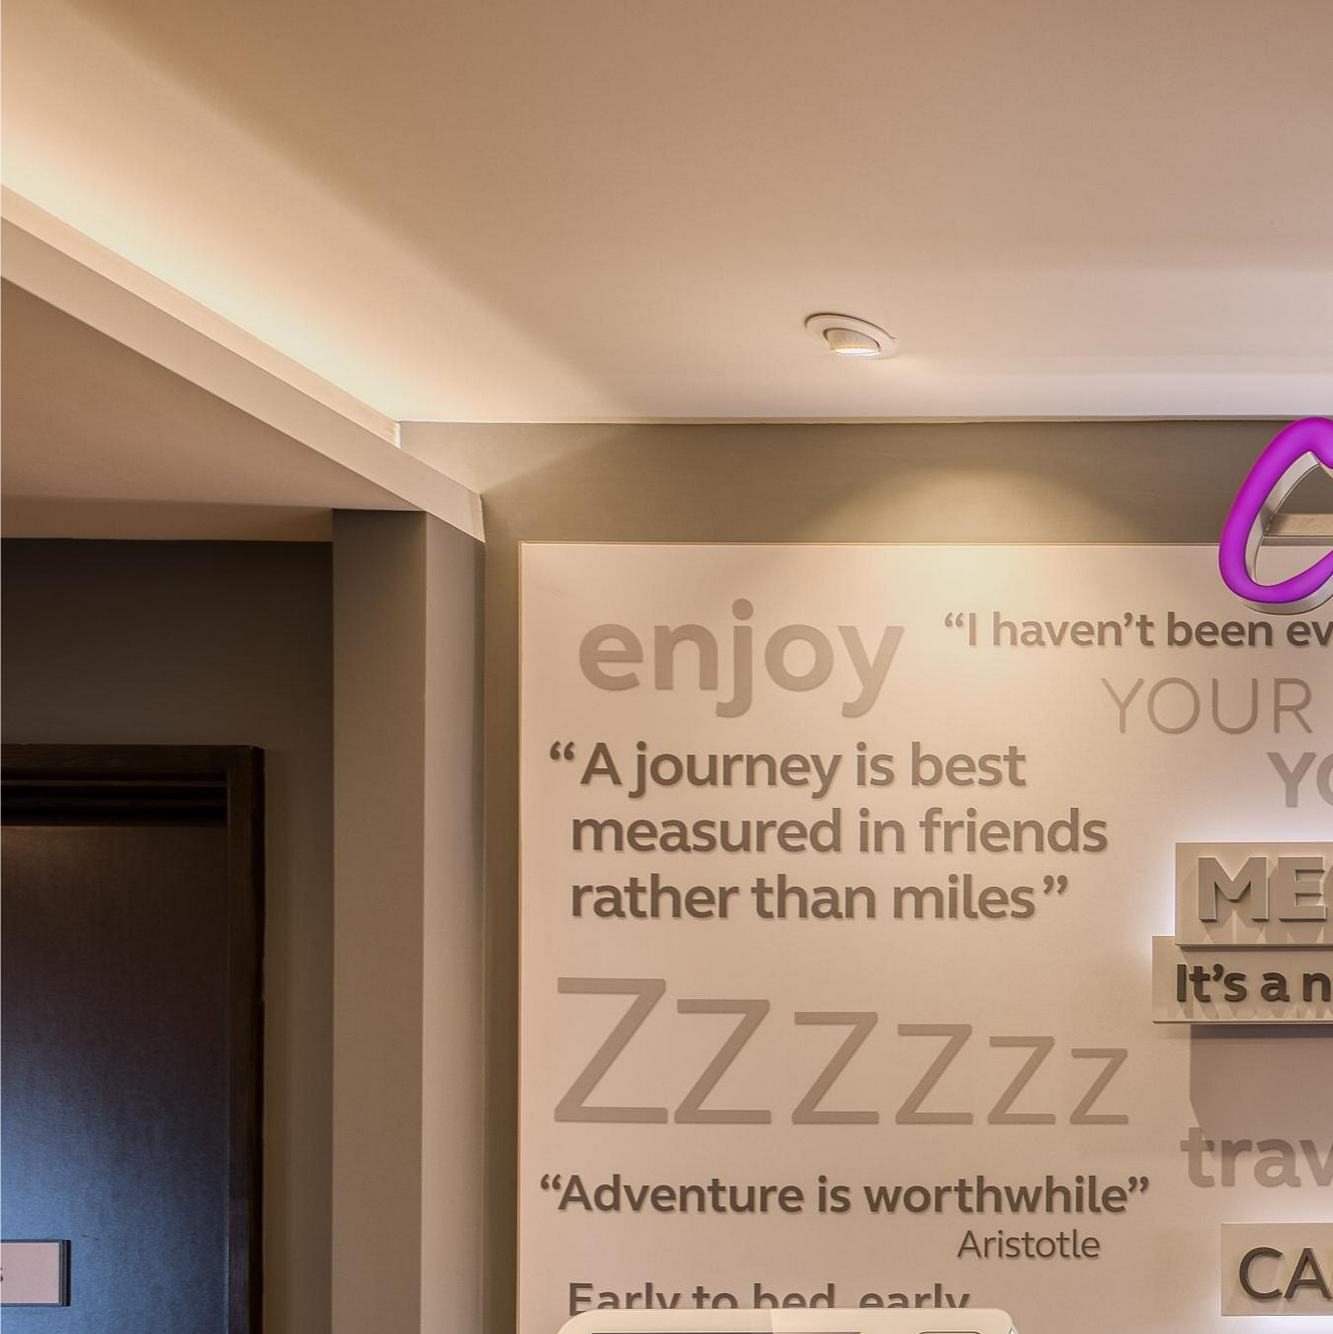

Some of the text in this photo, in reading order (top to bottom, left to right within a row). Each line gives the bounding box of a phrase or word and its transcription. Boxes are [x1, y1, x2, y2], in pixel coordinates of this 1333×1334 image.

[992, 612, 1154, 647] haven’t
[1166, 611, 1273, 646] been
[579, 598, 904, 717] enjoy
[1101, 677, 1313, 734] YOUR
[629, 741, 841, 799] journey
[856, 742, 894, 786] is
[910, 742, 1027, 786] best
[572, 808, 1107, 852] measured in friends
[572, 875, 1069, 919] rather than miles”
[1176, 963, 1247, 1003] It’s
[1260, 972, 1289, 1003] a
[540, 1174, 1149, 1214] “Adventure is worthwhile”
[957, 1230, 1101, 1259] Aristotle
[692, 1285, 738, 1309] to
